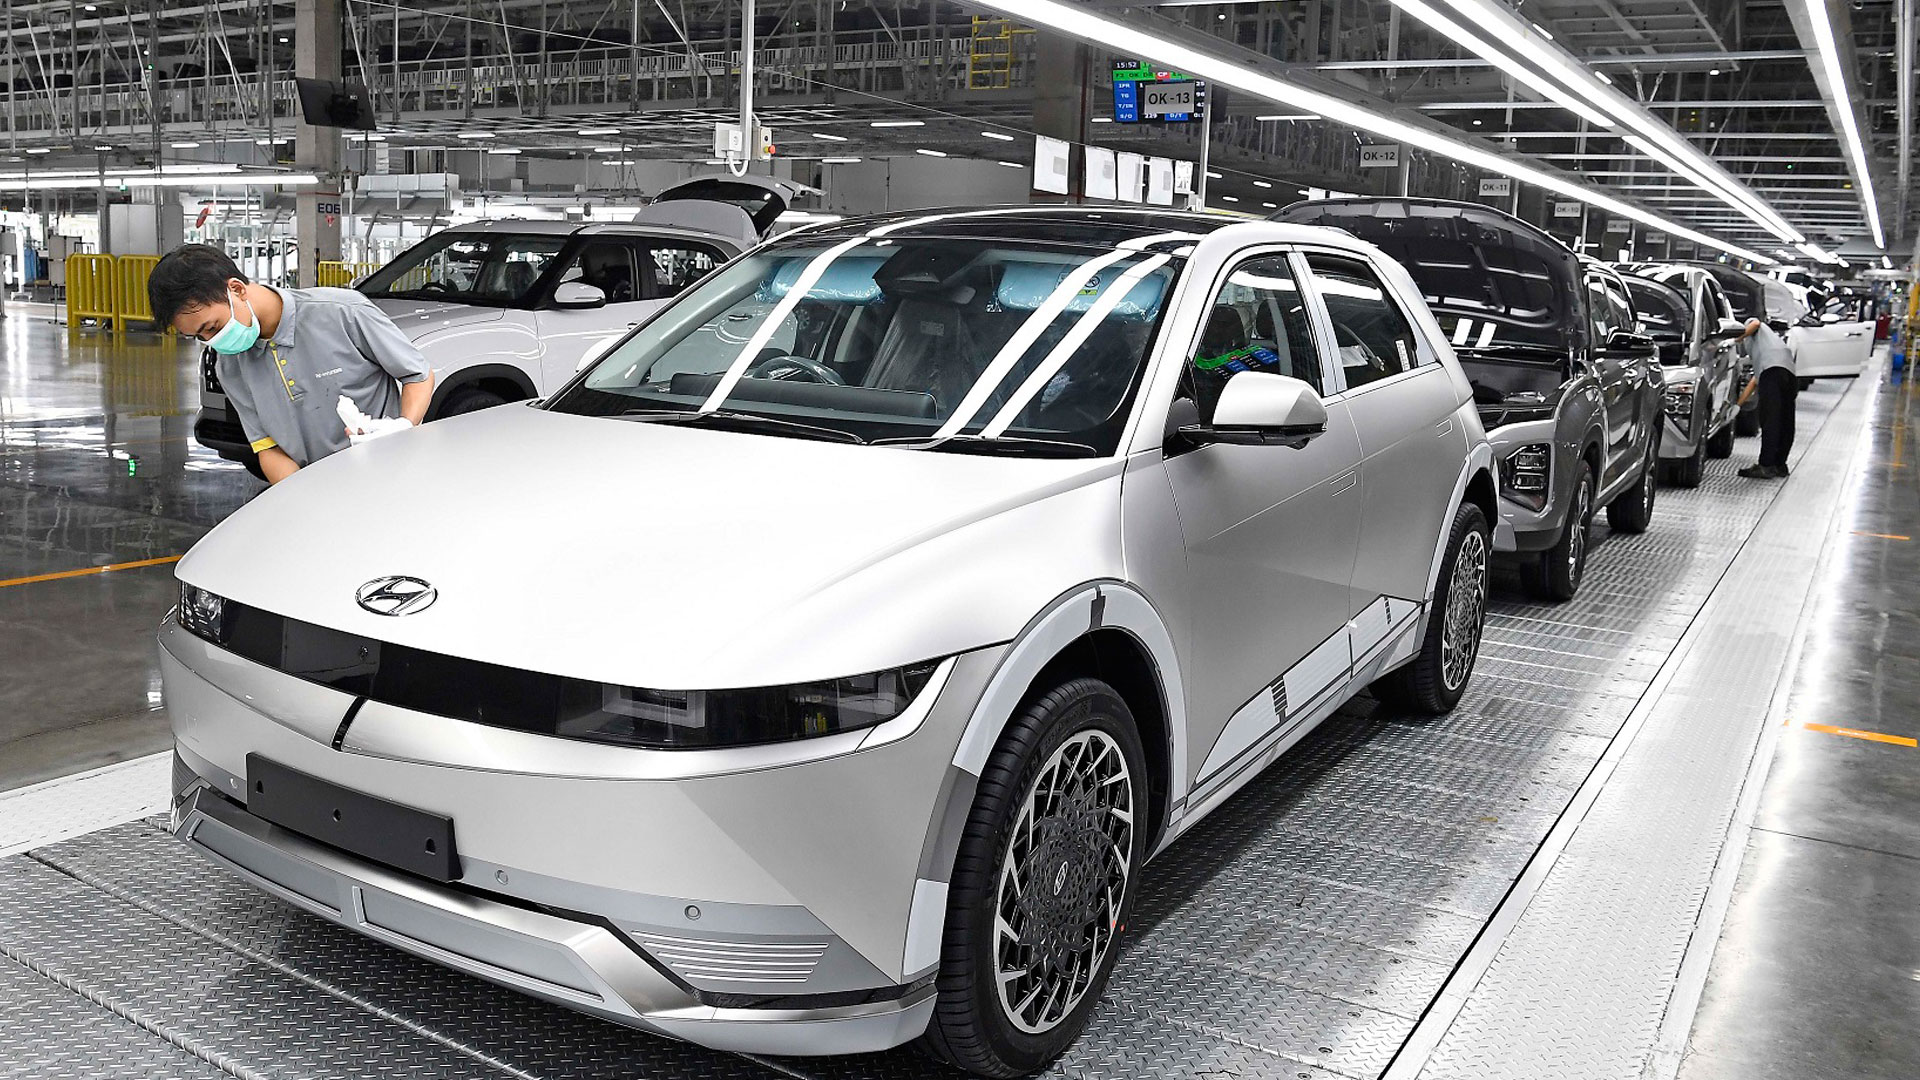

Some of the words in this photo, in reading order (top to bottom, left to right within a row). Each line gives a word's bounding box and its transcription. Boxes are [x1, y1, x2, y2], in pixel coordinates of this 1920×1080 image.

[1148, 92, 1190, 105] OK-13
[1363, 151, 1396, 161] OK-12
[1482, 183, 1508, 191] OK-11
[317, 202, 341, 214] E06
